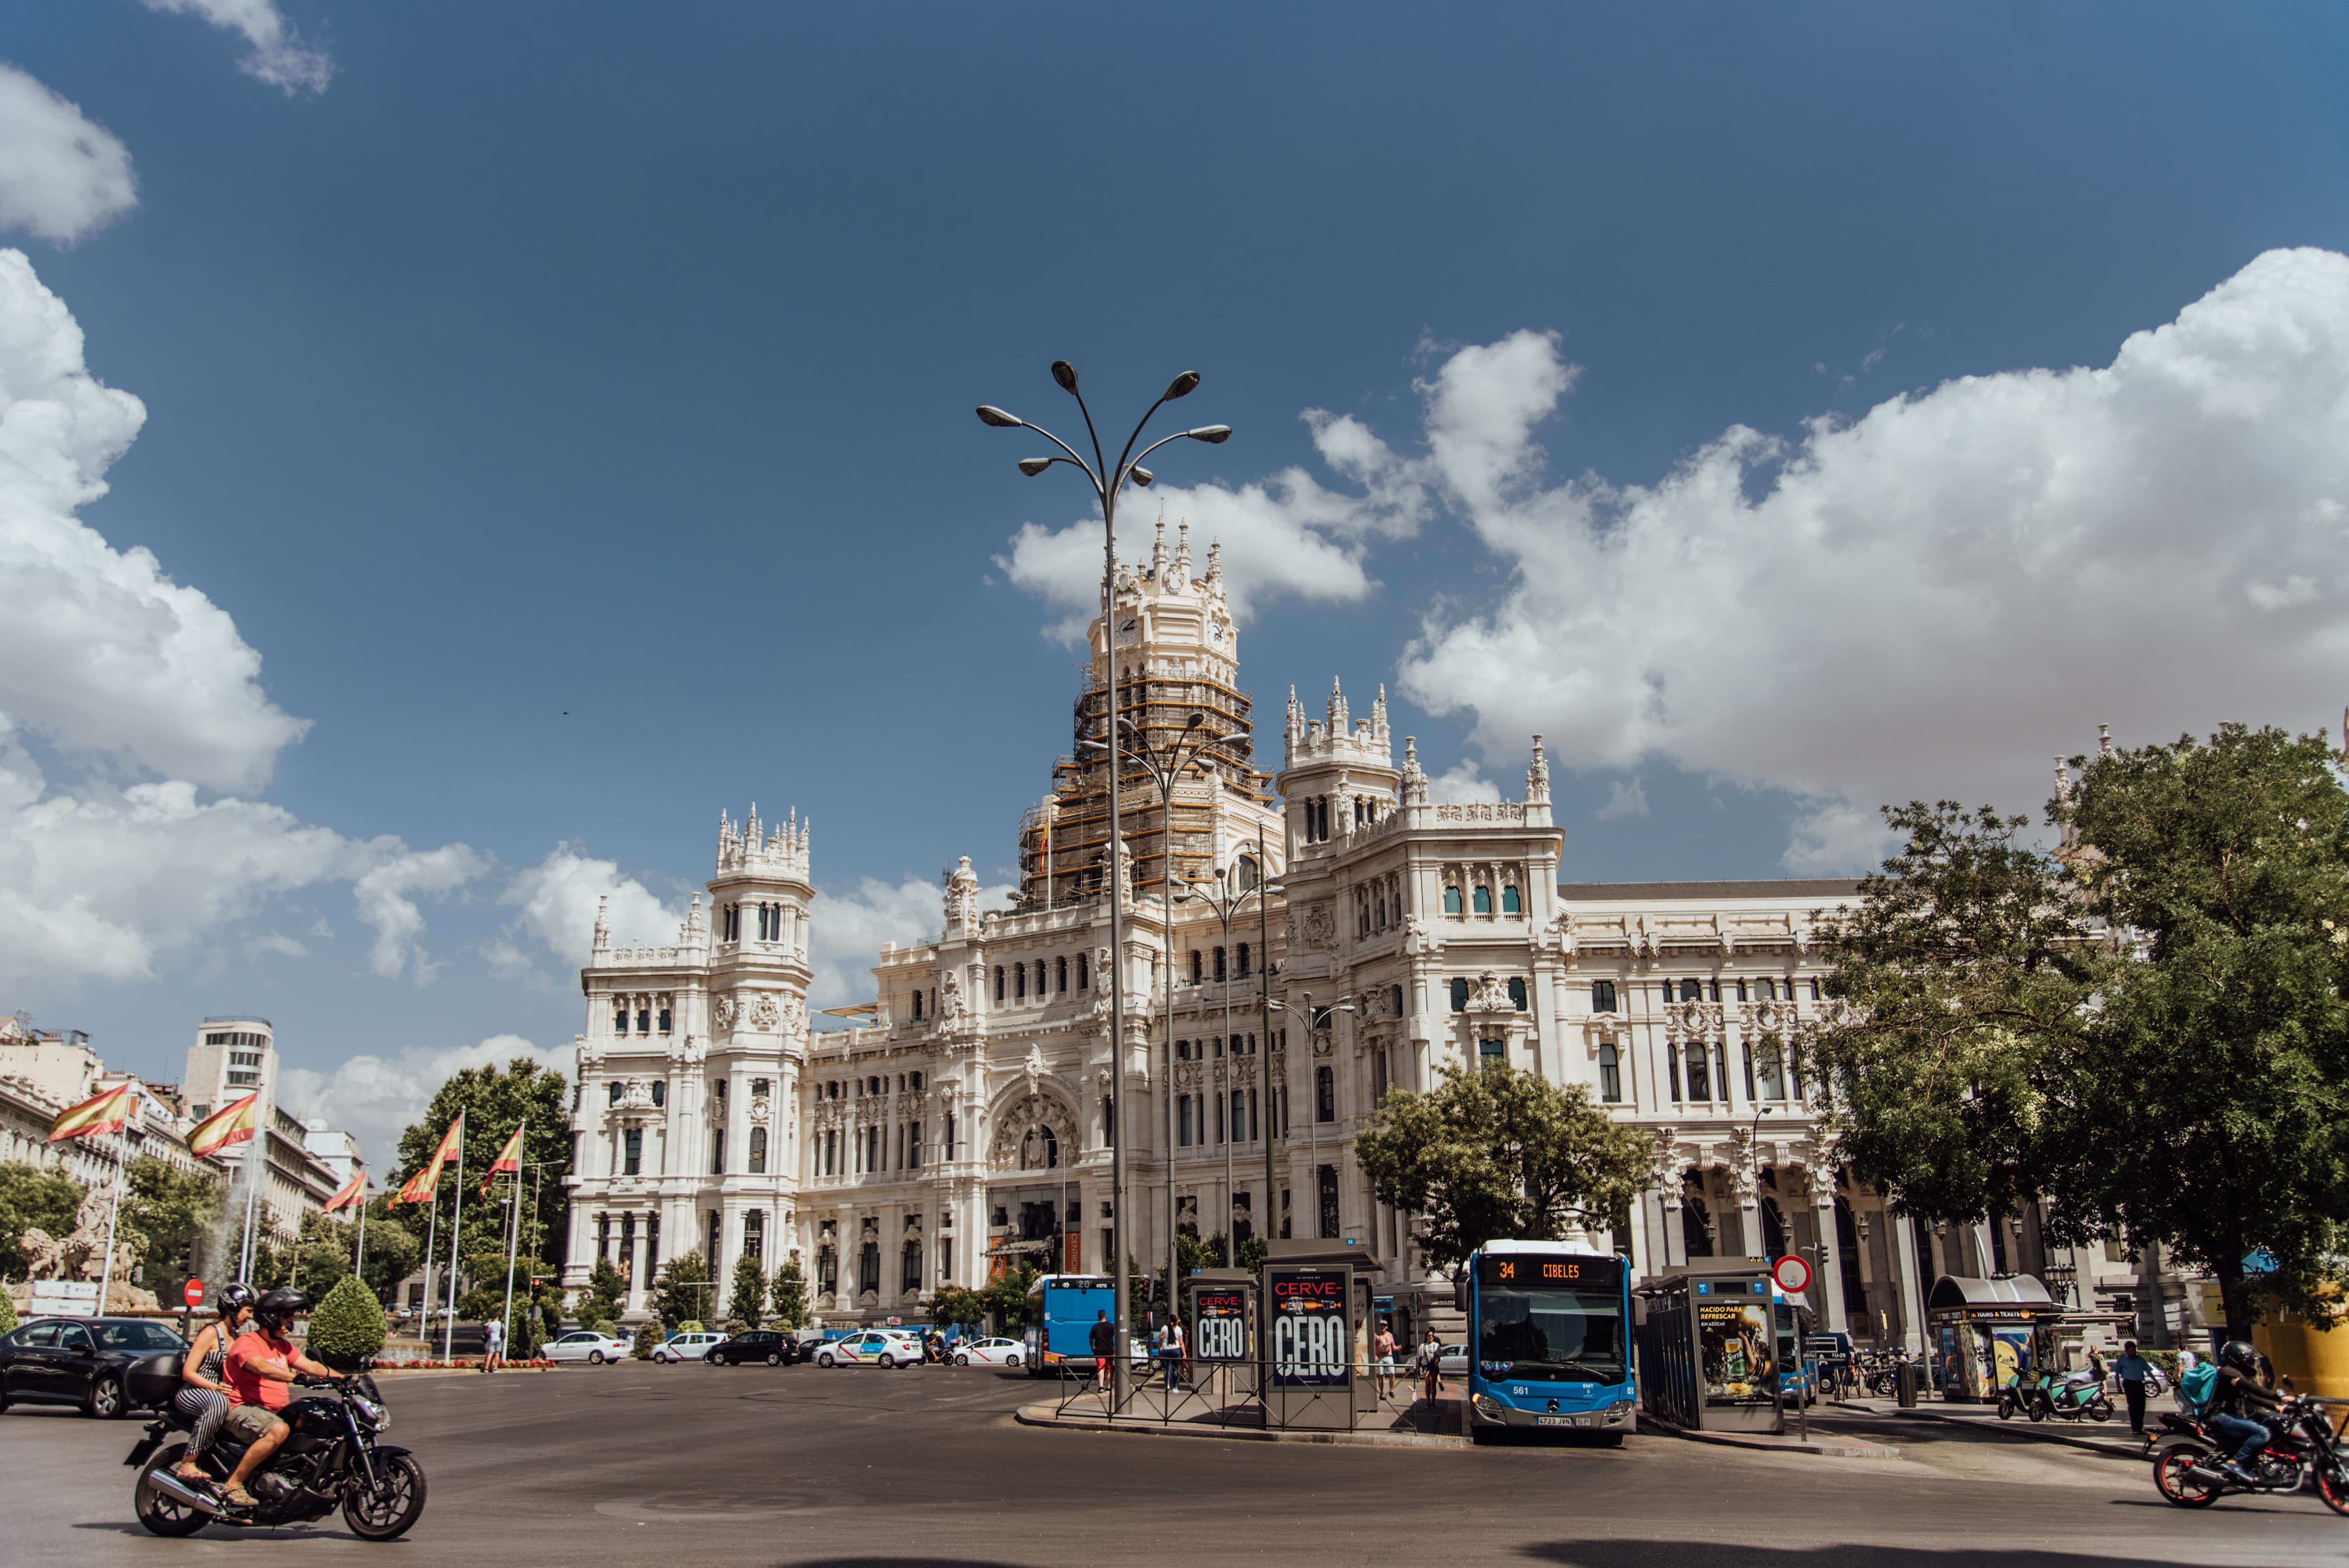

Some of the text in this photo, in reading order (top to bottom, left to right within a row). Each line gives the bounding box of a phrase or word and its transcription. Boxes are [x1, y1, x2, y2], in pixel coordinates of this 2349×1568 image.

[1500, 1262, 1579, 1278] 34 CIBELES
[1275, 1282, 1343, 1295] CERVE-
[1199, 1297, 1242, 1306] CERVE-
[1199, 1318, 1243, 1357] CERO
[1275, 1315, 1345, 1376] CERO
[1513, 1386, 1529, 1395] 561
